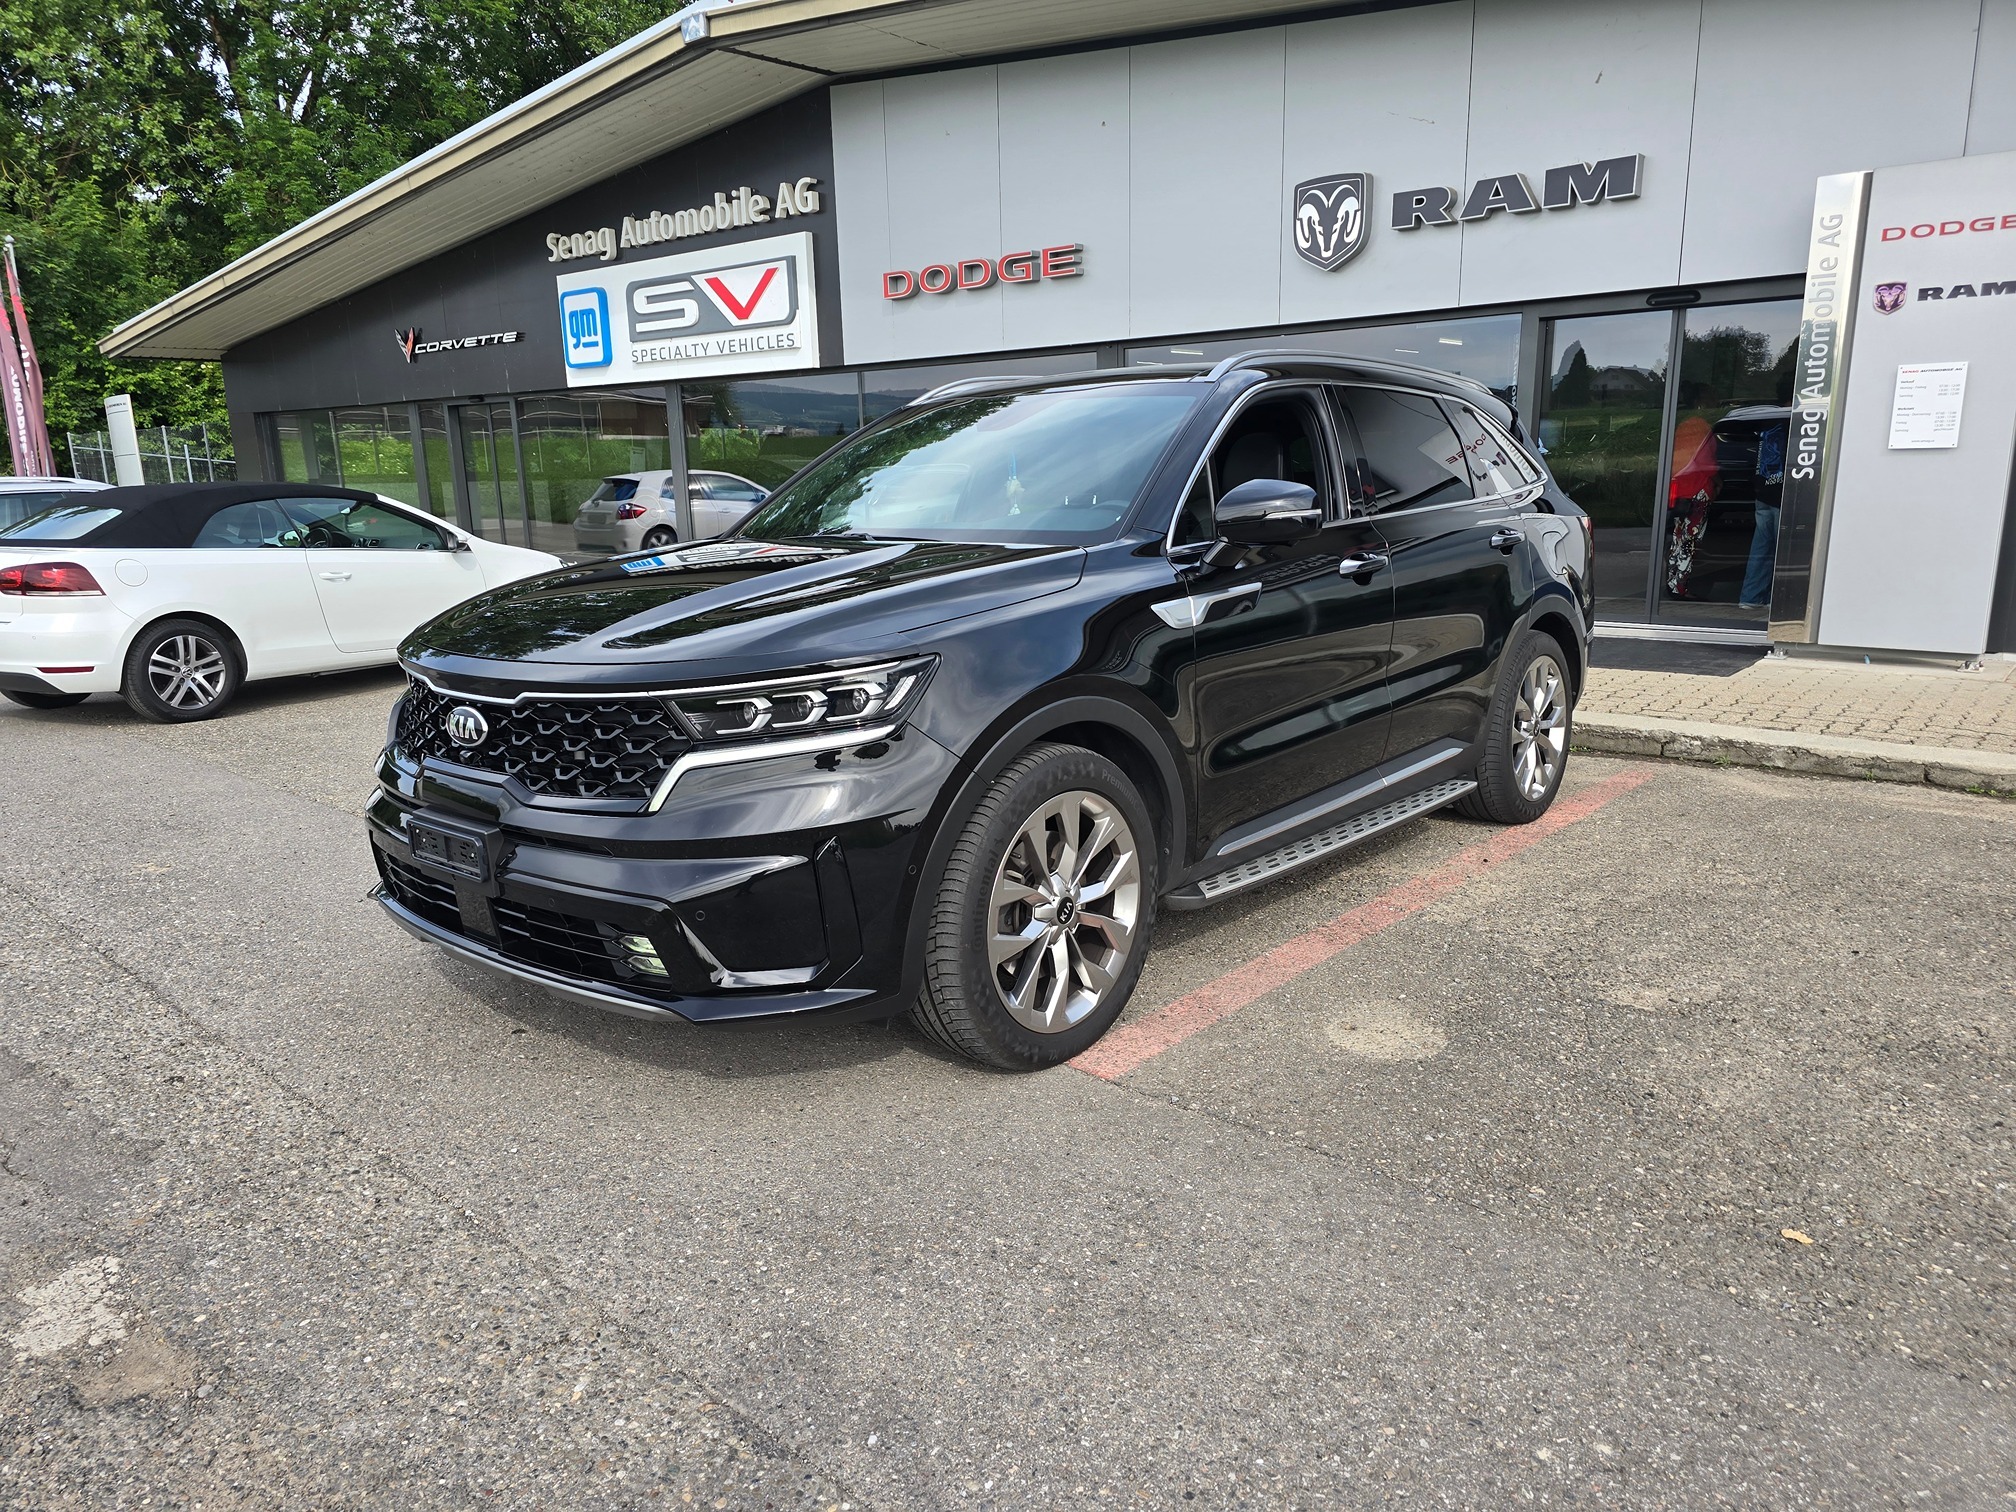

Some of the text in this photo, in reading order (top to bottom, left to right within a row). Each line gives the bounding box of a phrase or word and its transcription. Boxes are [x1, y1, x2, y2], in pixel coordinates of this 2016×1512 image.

[1391, 153, 1645, 231] RAM
[546, 177, 819, 262] Senag Automobile AG
[1881, 215, 2016, 242] DODGE
[882, 243, 1084, 300] DODGE
[633, 267, 779, 333] SV
[1917, 281, 2016, 302] RAM
[415, 331, 518, 354] CORVETTE
[569, 307, 598, 350] gm
[1791, 213, 1843, 479] Senag Automobile AG
[632, 333, 796, 363] SPECIALTY VEHICLES
[450, 713, 478, 739] KIA
[1059, 902, 1075, 922] KIA
